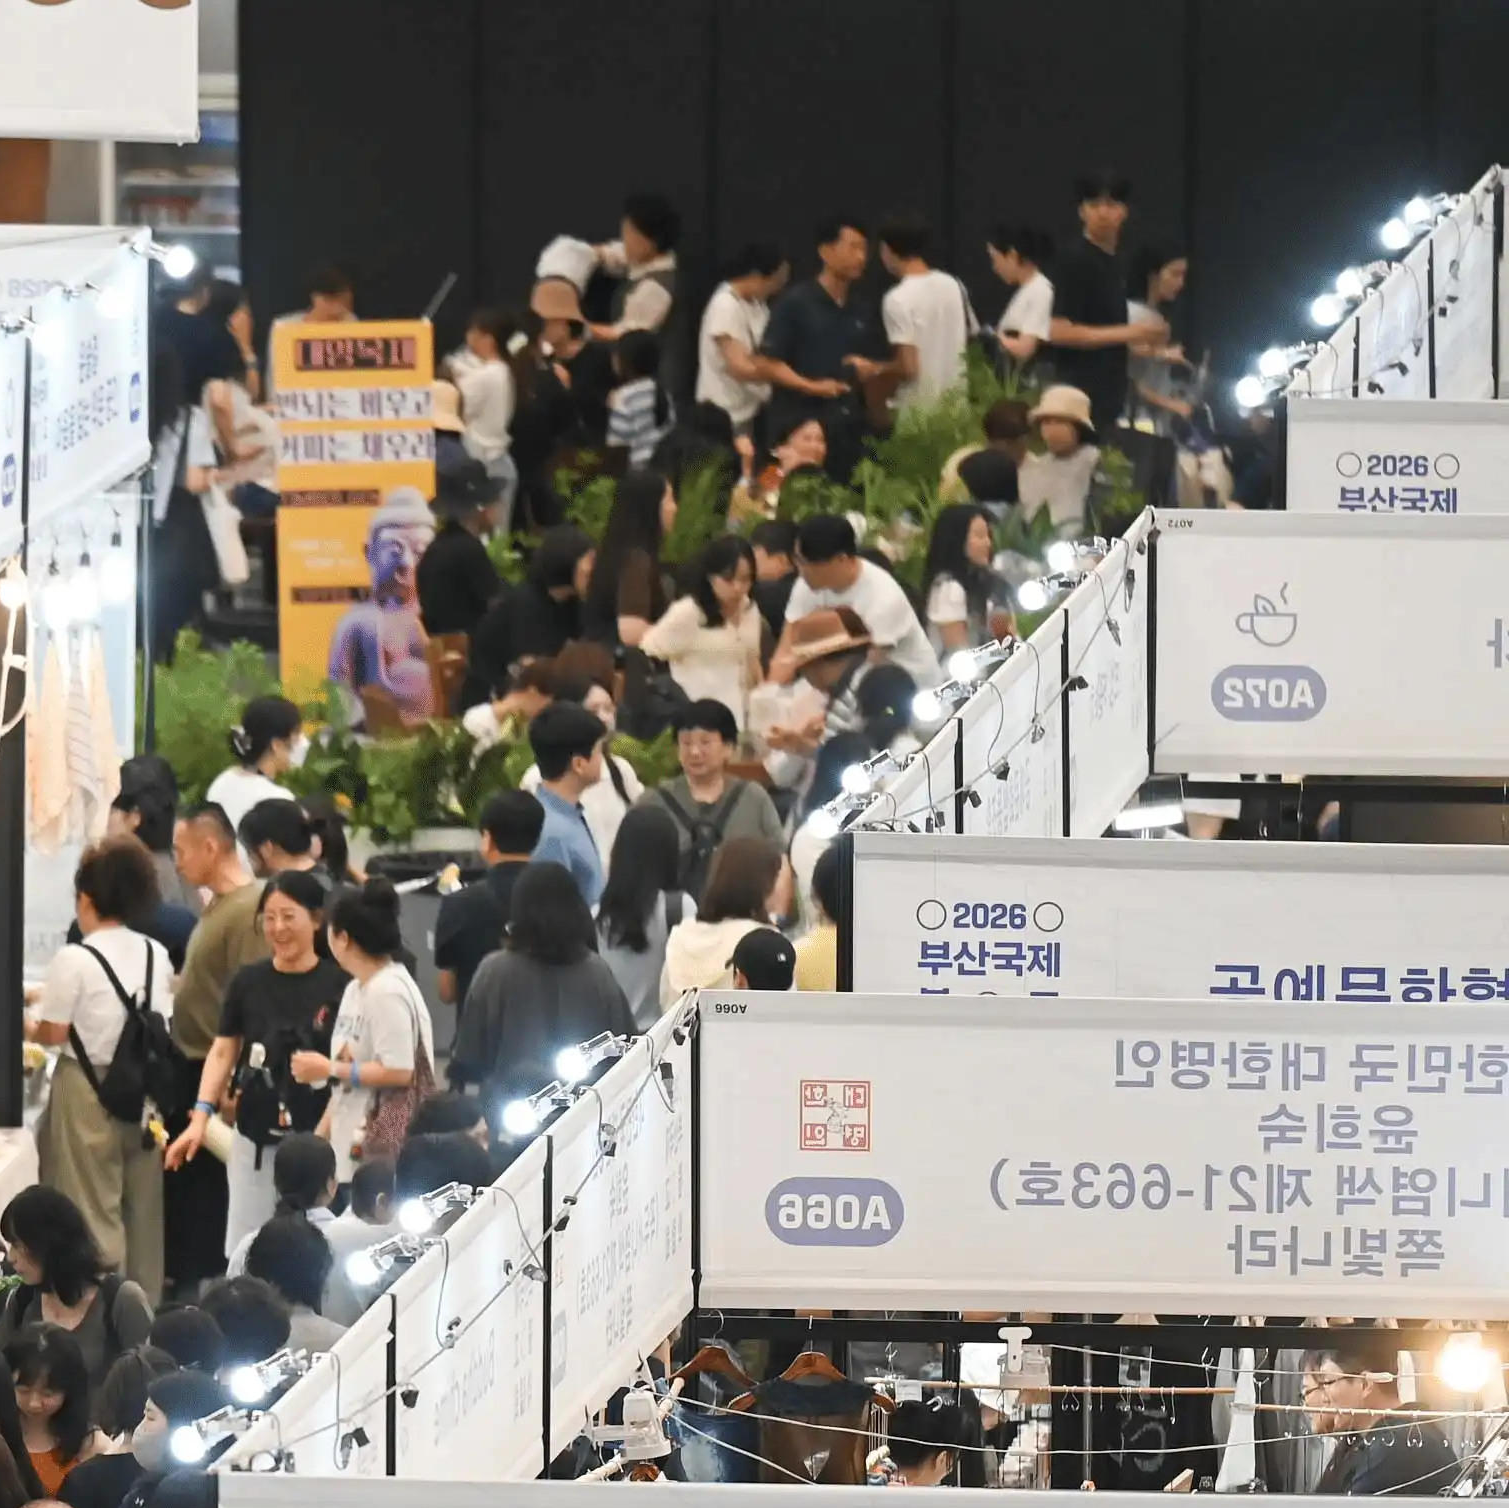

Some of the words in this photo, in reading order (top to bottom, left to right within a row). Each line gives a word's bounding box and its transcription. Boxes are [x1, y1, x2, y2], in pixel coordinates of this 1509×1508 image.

[1367, 454, 1429, 477] 2026
[953, 902, 1027, 930] 2026
[917, 940, 1061, 978] 부산국제
